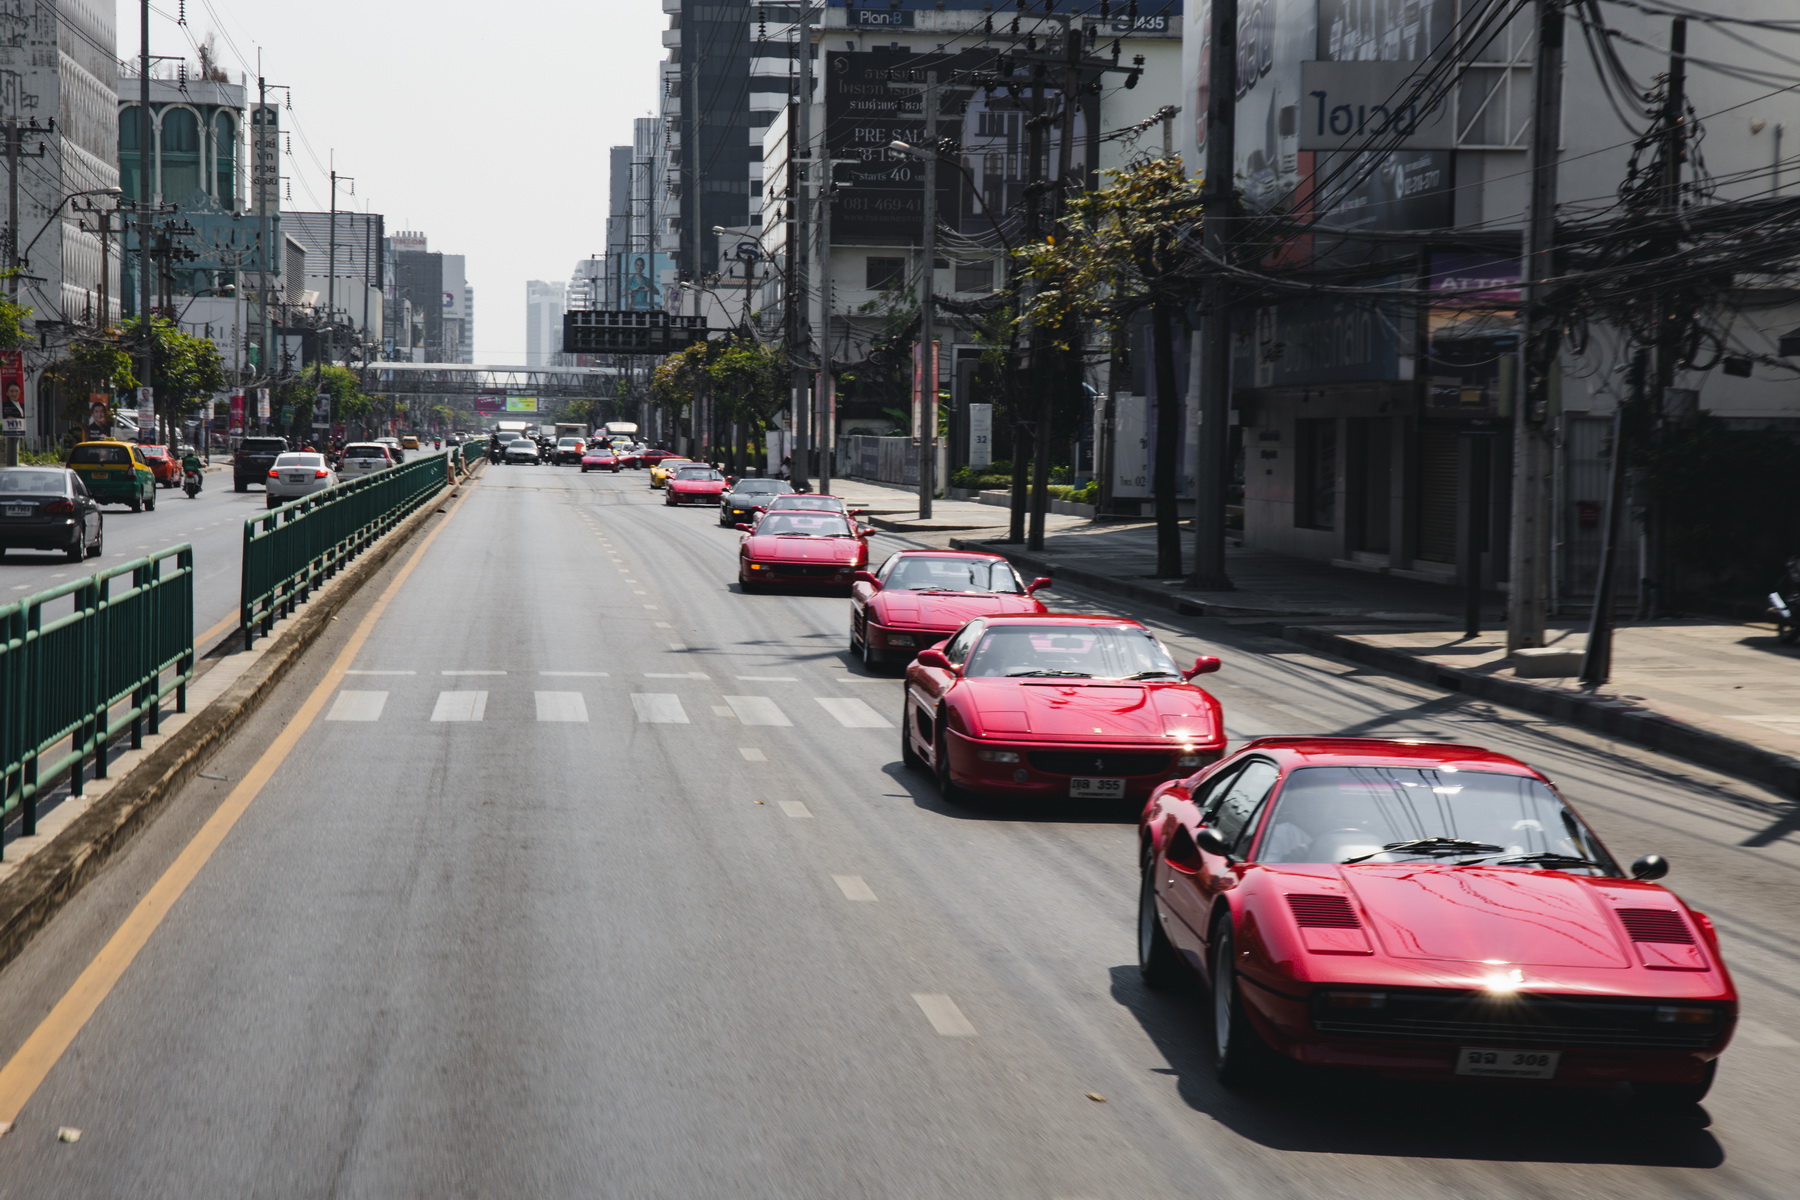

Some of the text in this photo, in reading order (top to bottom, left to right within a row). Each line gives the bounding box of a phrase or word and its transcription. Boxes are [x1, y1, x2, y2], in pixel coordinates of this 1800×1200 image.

[855, 128, 928, 144] PRE SAL
[859, 171, 887, 181] starts
[890, 167, 911, 181] 40
[393, 238, 426, 246] UNION
[976, 435, 987, 444] 32
[1097, 779, 1120, 790] 355
[1512, 1053, 1550, 1066] 308
